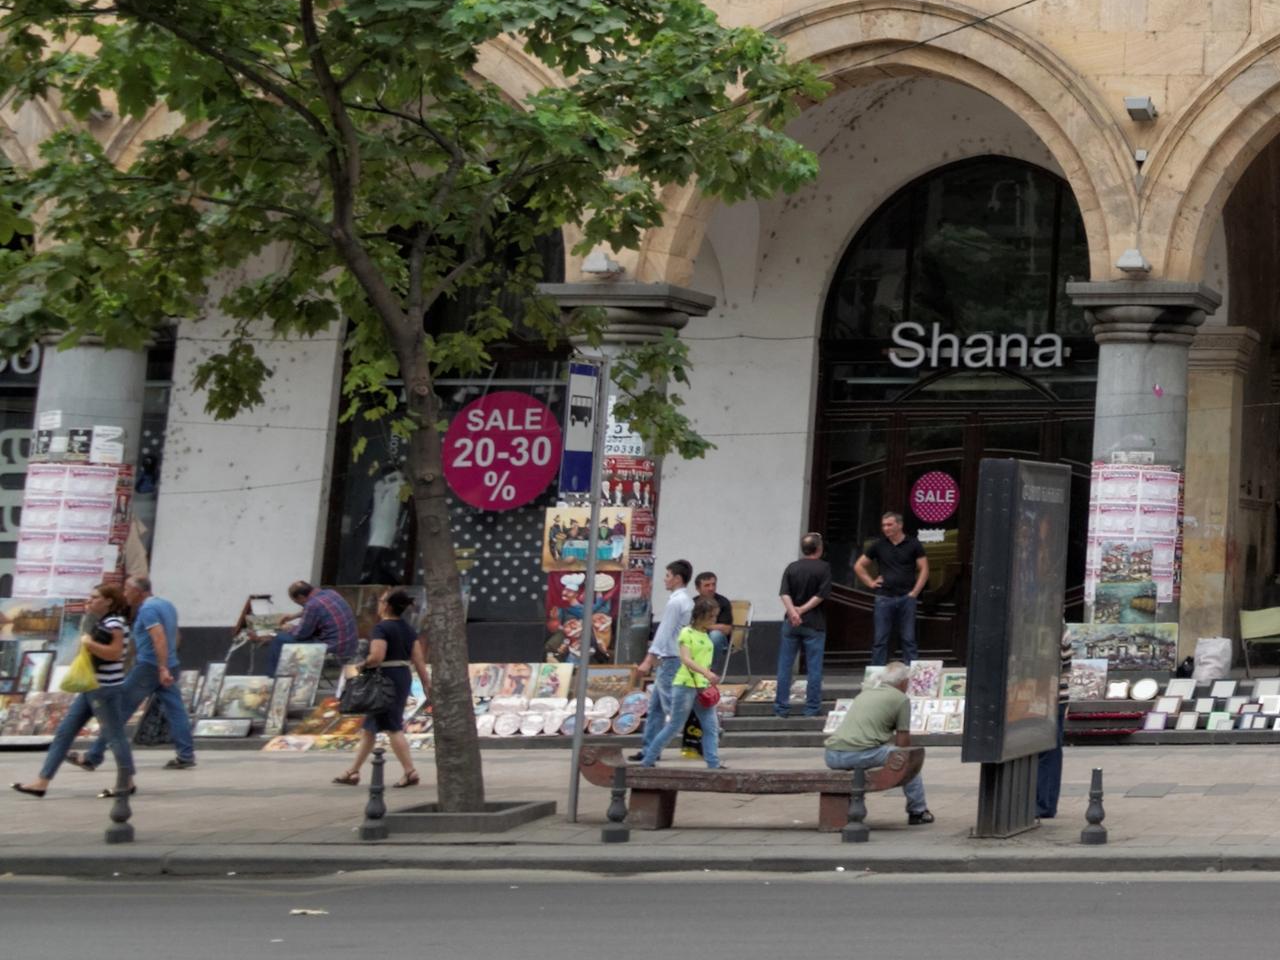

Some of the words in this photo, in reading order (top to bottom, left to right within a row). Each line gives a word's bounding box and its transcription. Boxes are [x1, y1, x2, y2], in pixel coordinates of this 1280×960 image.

[889, 321, 1063, 368] Shana
[466, 408, 543, 431] SALE
[453, 436, 552, 468] 20-30
[484, 470, 516, 501] %
[914, 489, 956, 503] SALE
